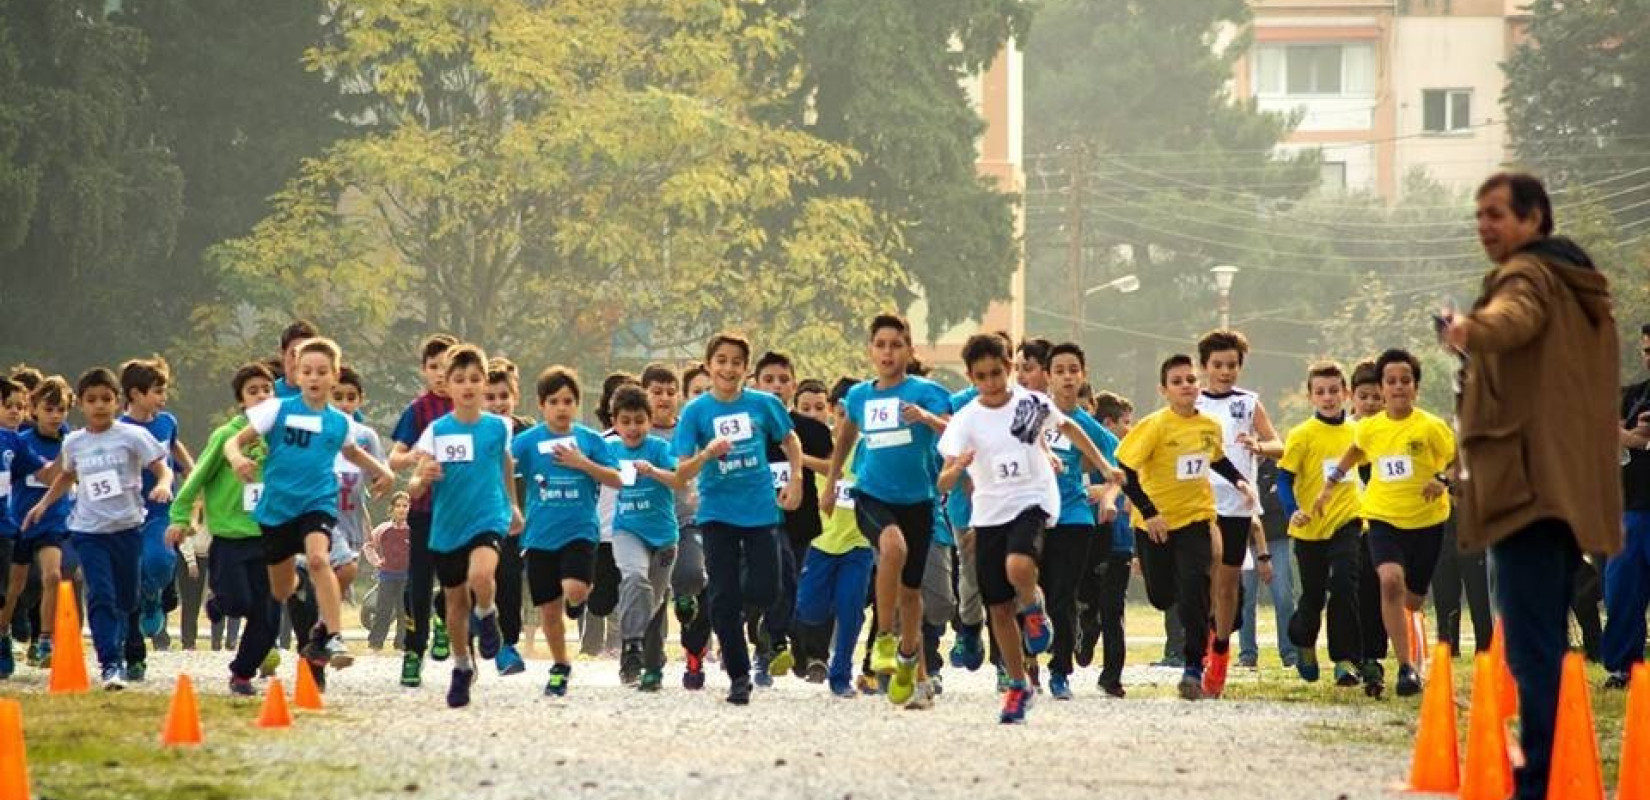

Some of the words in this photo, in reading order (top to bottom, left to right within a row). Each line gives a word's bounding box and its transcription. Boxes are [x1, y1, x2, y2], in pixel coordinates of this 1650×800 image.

[870, 406, 889, 424] 76
[720, 419, 740, 436] 63
[446, 444, 467, 459] 99
[999, 461, 1021, 479] 32
[1185, 459, 1204, 475] 17
[1386, 460, 1406, 476] 18
[91, 480, 111, 496] 35
